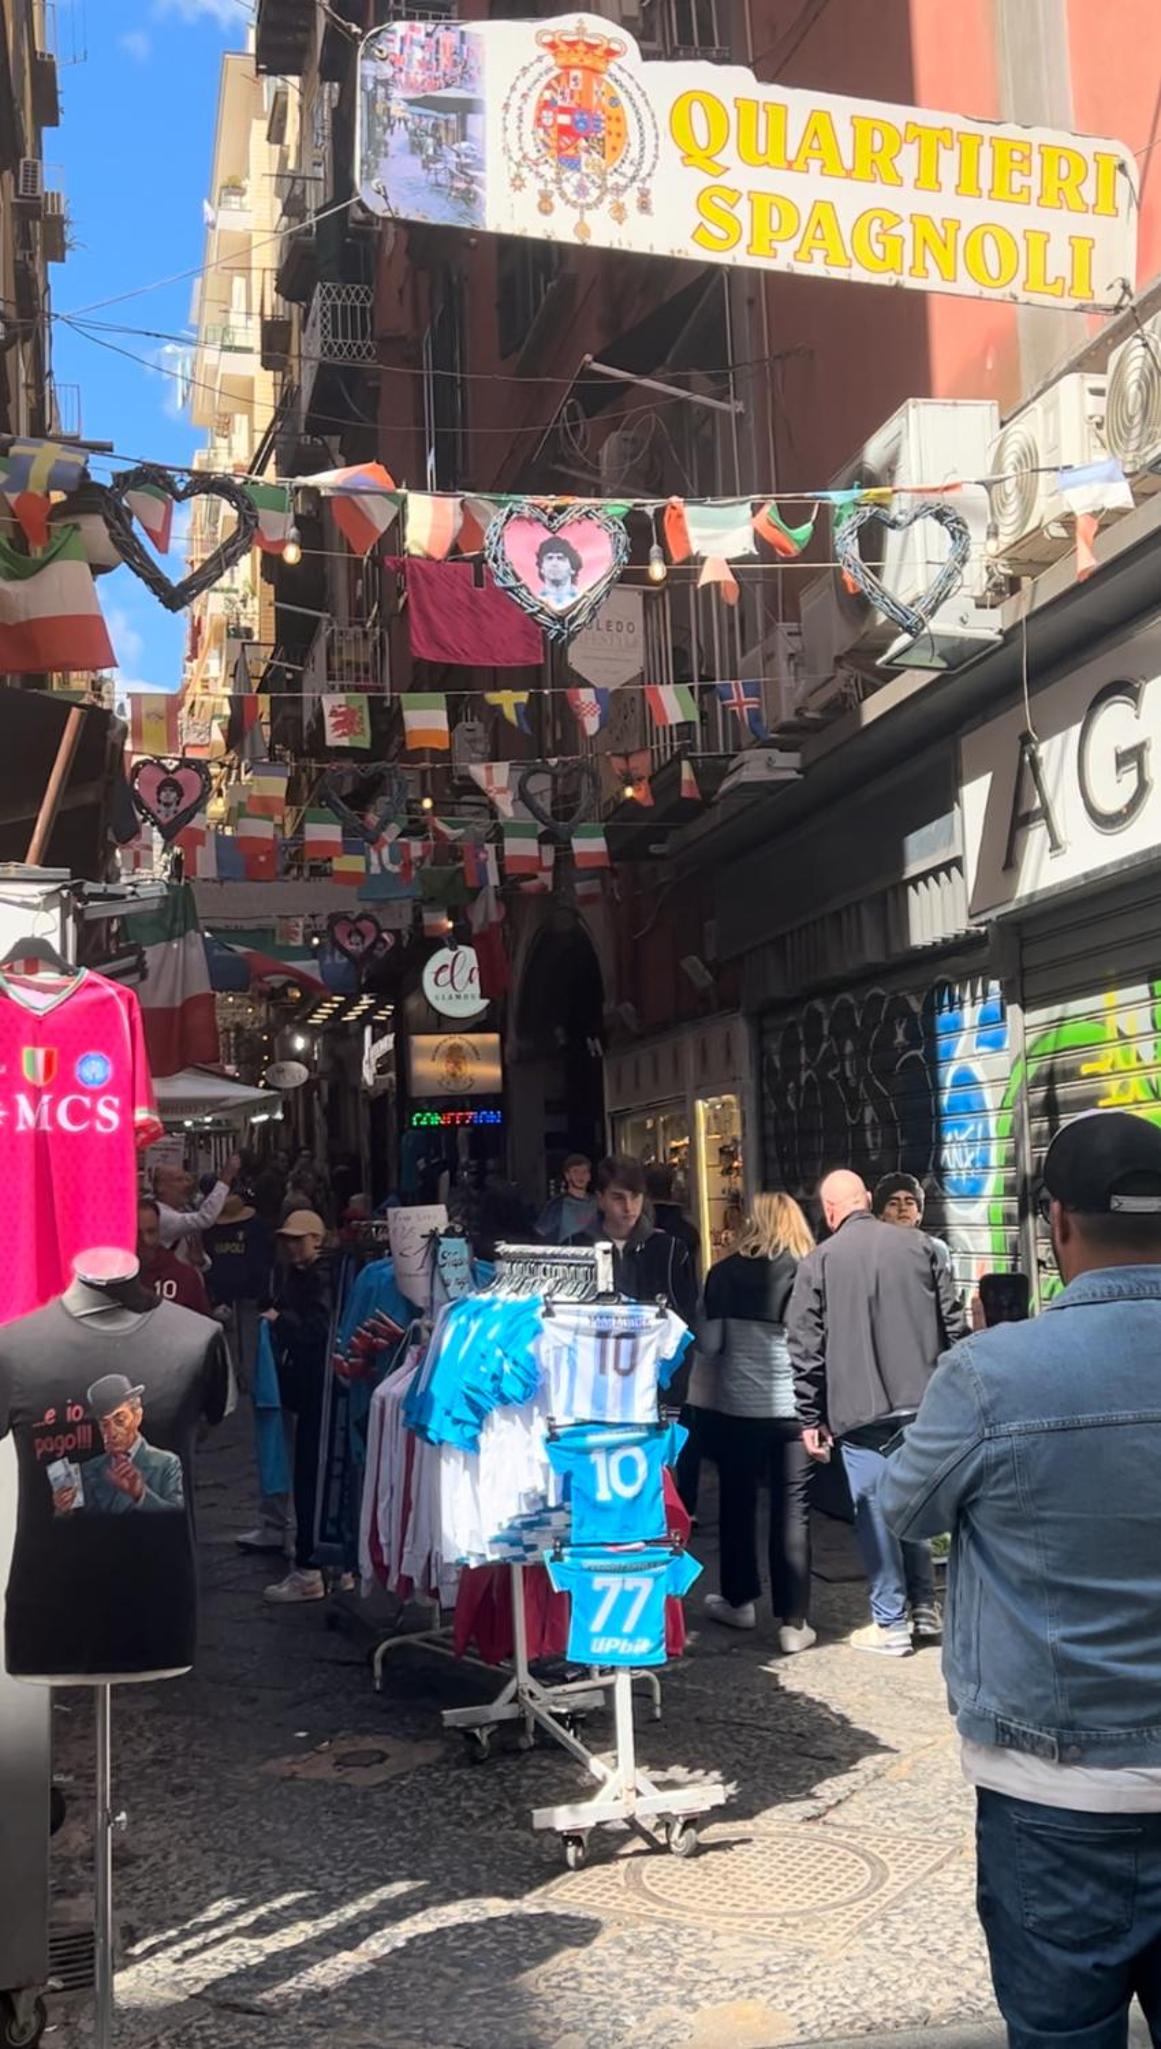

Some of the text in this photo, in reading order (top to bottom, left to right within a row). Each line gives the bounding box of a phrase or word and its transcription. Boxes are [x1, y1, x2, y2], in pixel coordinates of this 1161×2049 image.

[669, 88, 1121, 217] QUARTIERI
[690, 184, 1095, 300] SPAGNOLI
[15, 1093, 120, 1132] MCS
[154, 1279, 178, 1299] 10
[594, 1331, 640, 1377] 10
[590, 1445, 649, 1501] 10
[589, 1576, 655, 1633] 77
